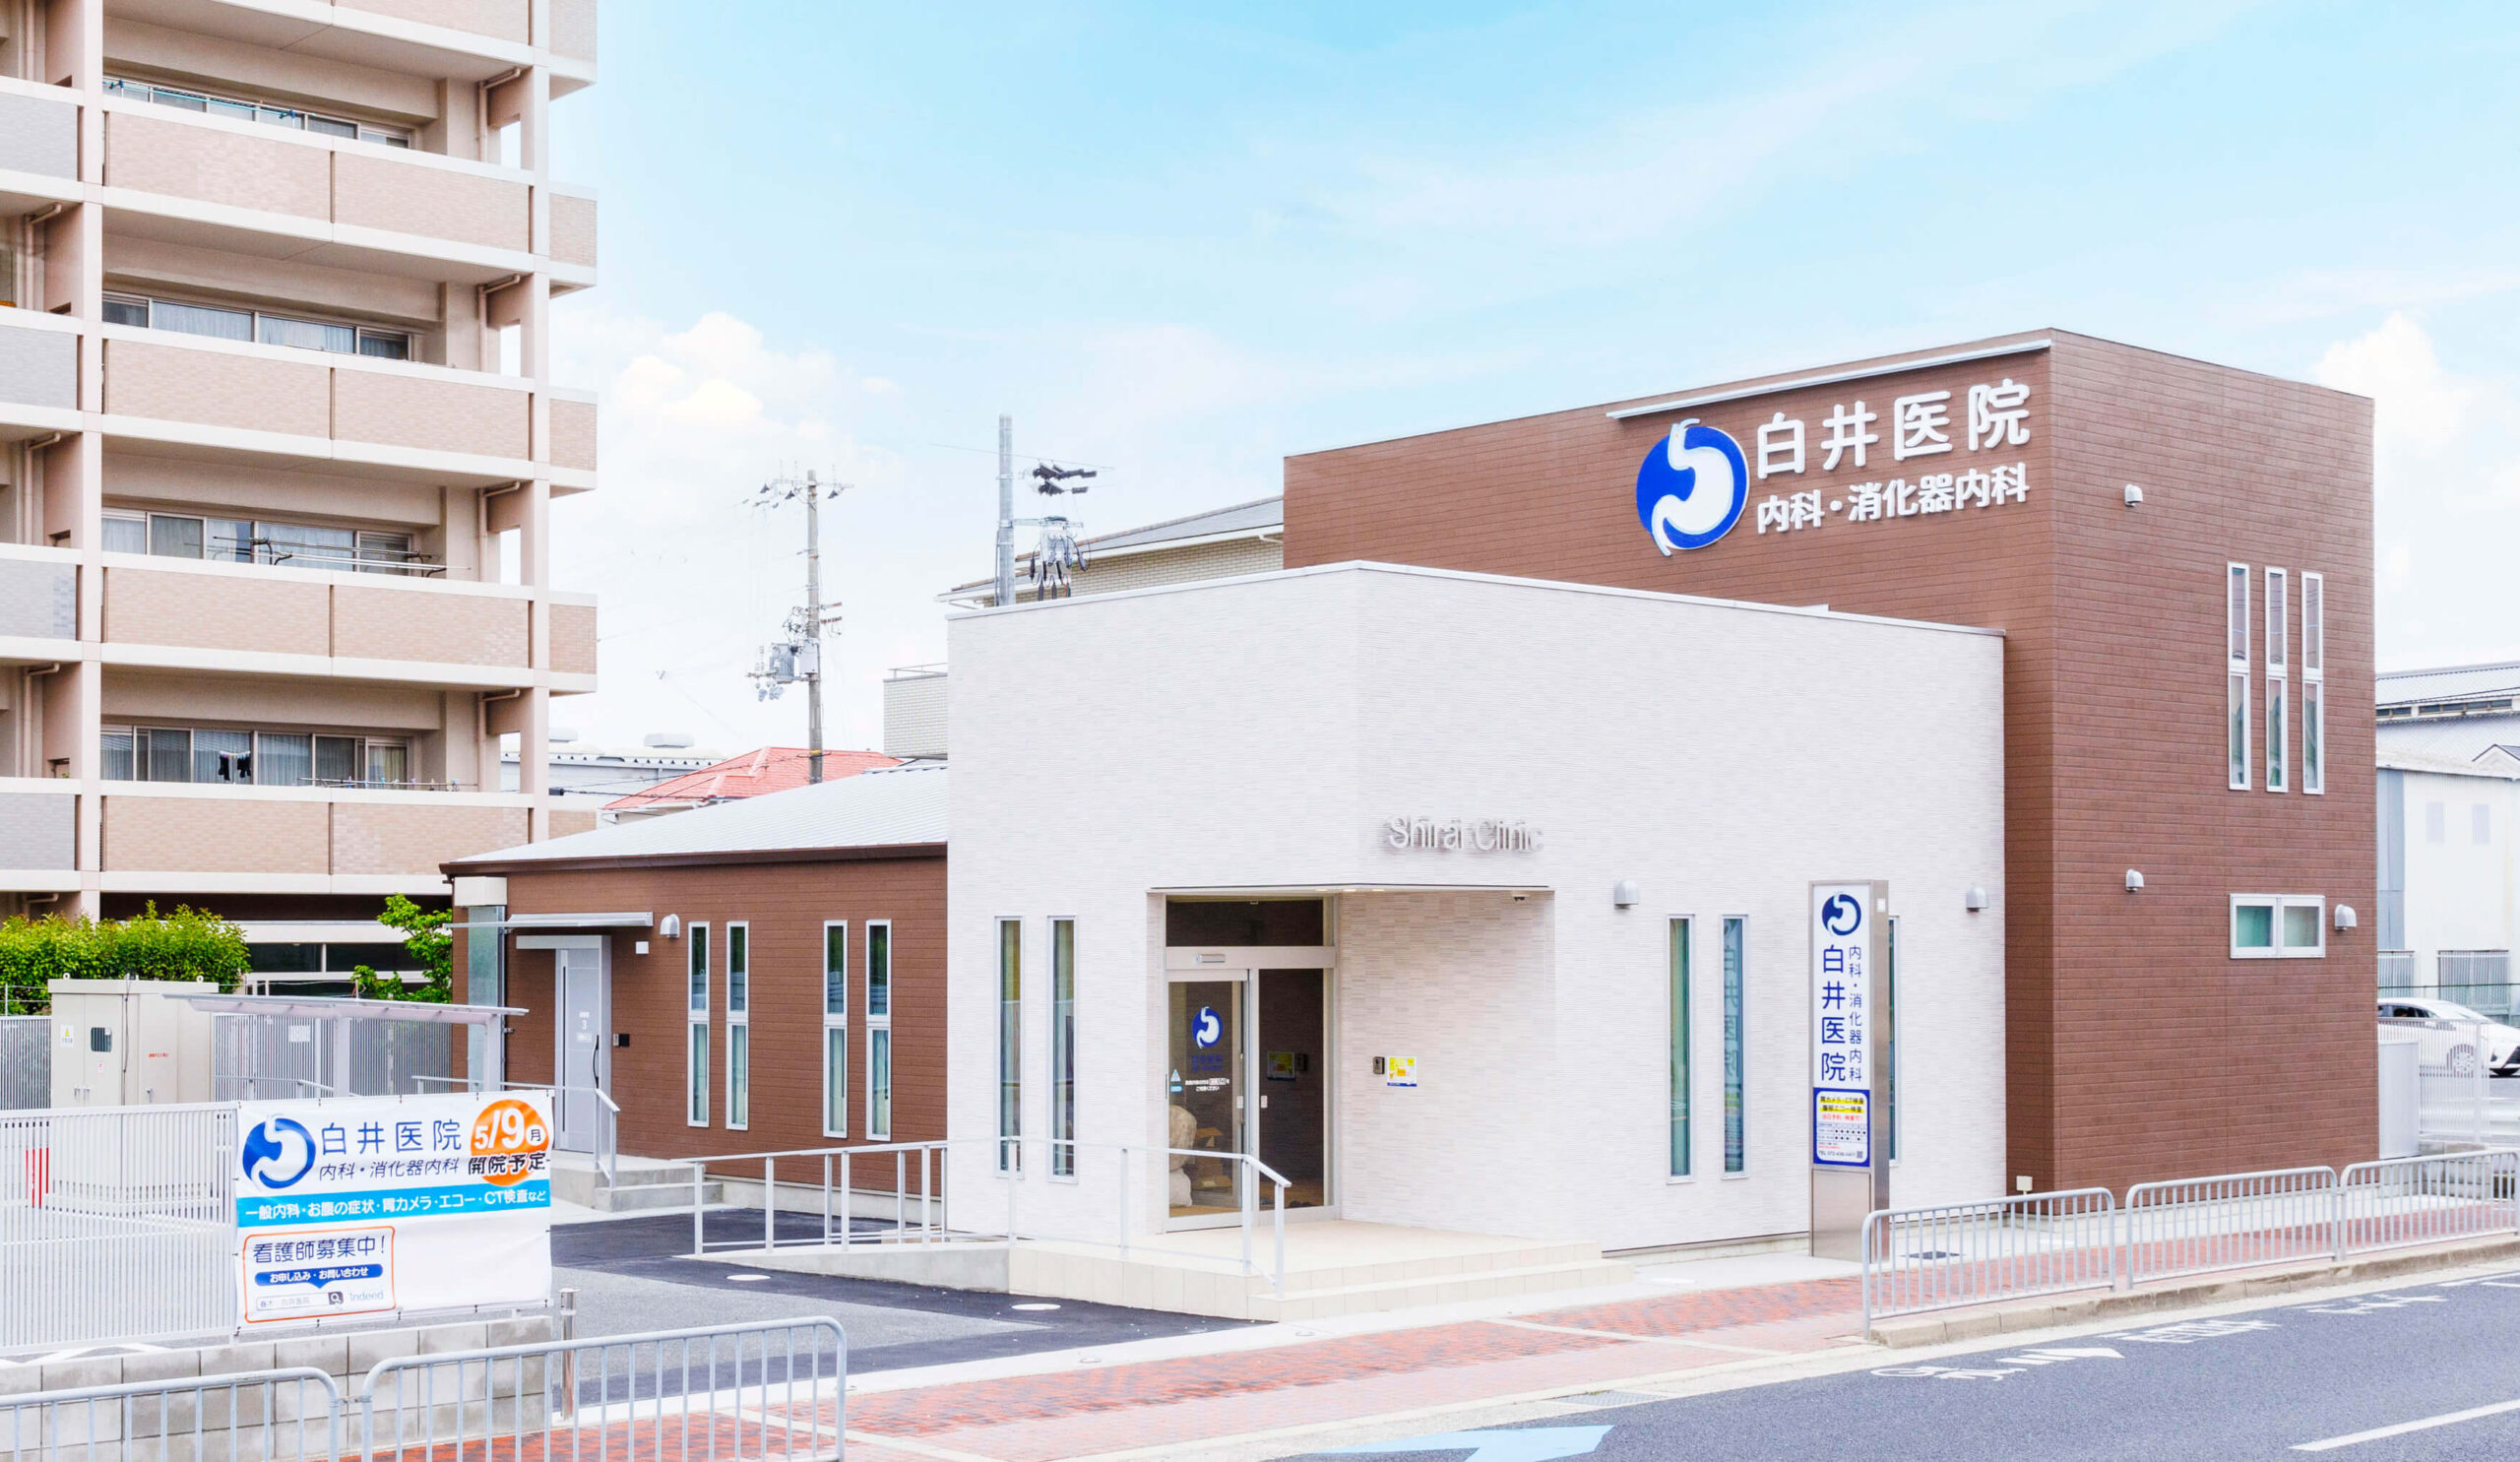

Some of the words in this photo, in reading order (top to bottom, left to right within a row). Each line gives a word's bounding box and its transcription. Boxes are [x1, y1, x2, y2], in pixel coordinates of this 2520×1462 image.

[1757, 378, 2030, 479] 白井医院
[1757, 462, 2030, 535] 内科・消化器内科
[1821, 944, 1846, 1081] 白井医院
[1849, 945, 1862, 1082] 内科・消化器内科
[321, 1118, 462, 1156] 白井医院
[473, 1108, 525, 1150] 5/9
[531, 1128, 541, 1142] 月
[319, 1157, 460, 1181] 内科・消化器内科
[468, 1152, 546, 1176] 開院予定
